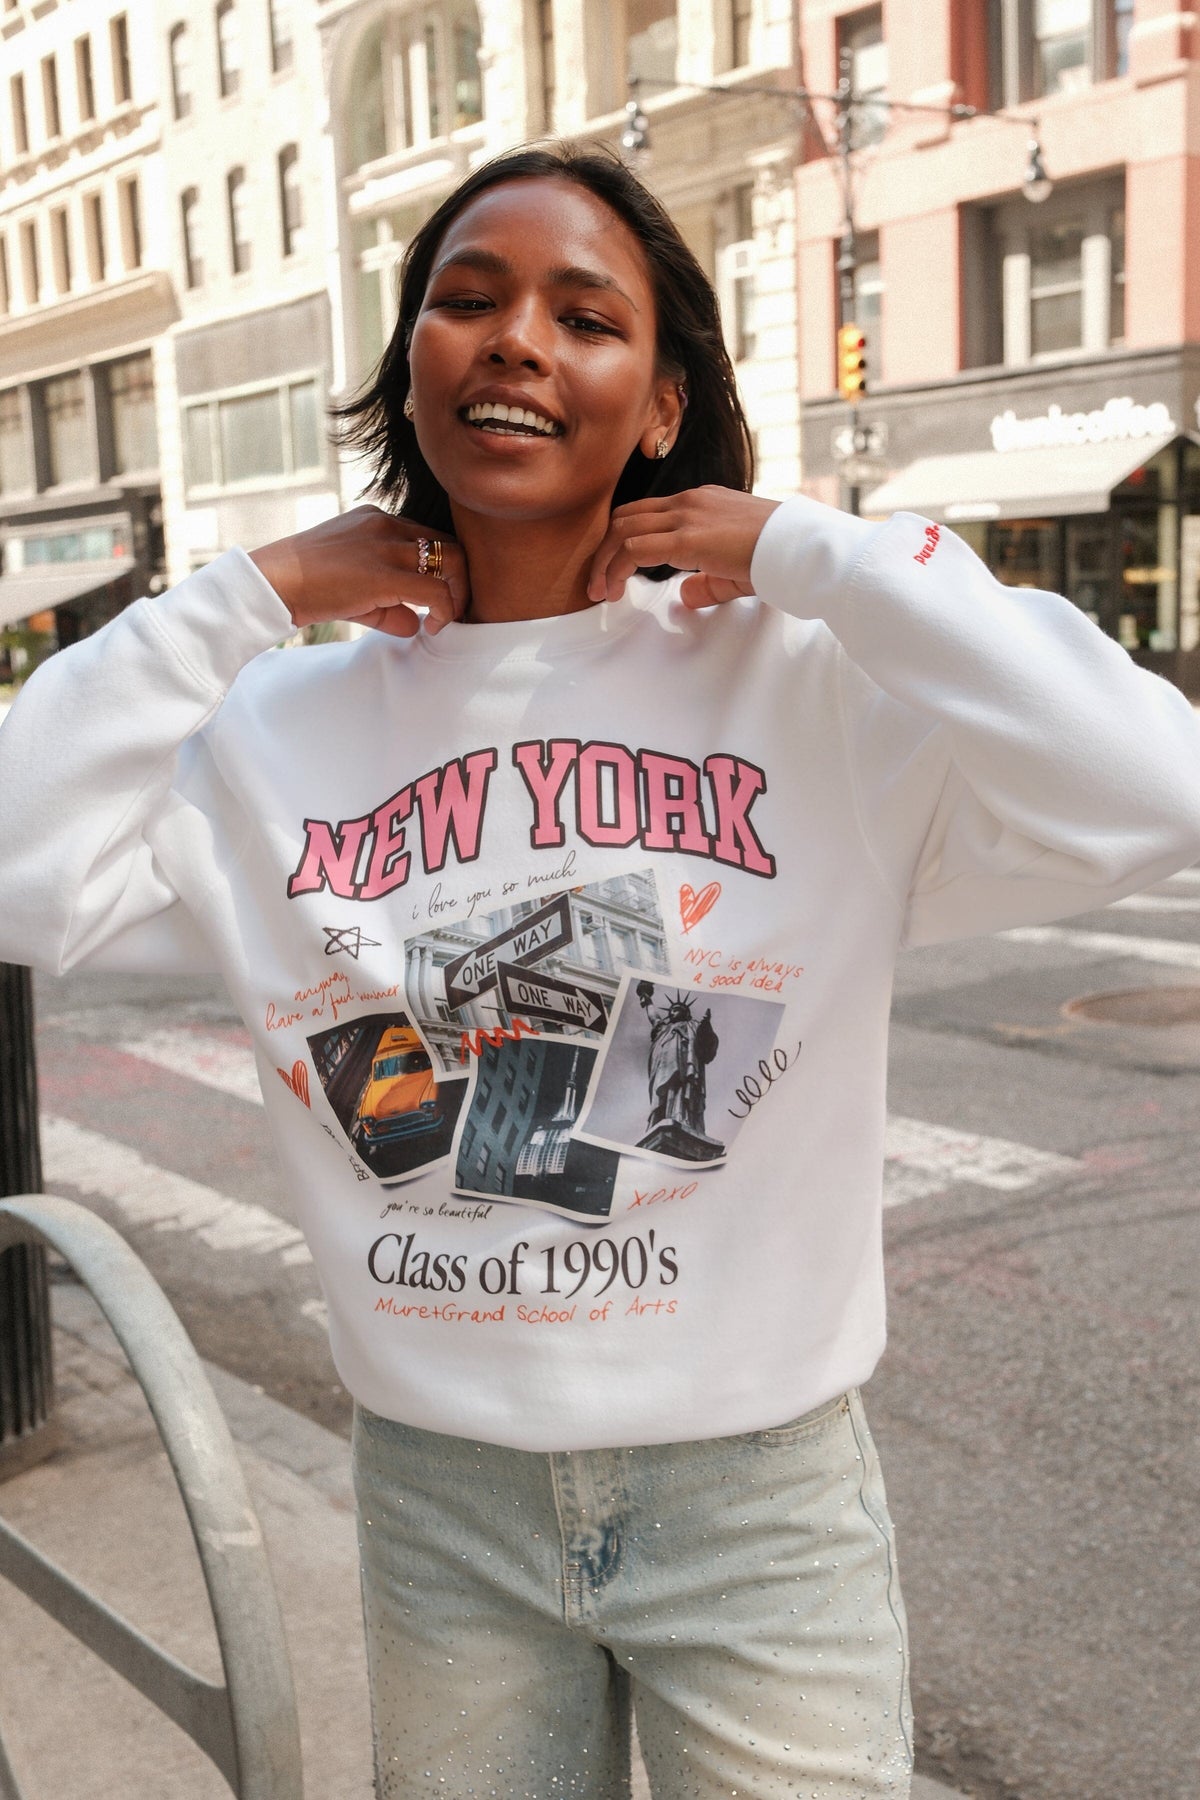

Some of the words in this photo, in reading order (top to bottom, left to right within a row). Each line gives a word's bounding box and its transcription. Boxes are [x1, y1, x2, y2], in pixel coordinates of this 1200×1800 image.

[287, 747, 498, 902] NEW
[512, 738, 777, 880] YORK
[428, 882, 458, 918] love
[466, 888, 492, 919] you
[502, 881, 520, 896] so
[527, 850, 577, 888] much
[462, 952, 497, 986] ONE
[513, 919, 553, 957] WAY
[684, 948, 722, 968] NYC
[728, 955, 742, 971] is
[747, 958, 805, 981] always
[693, 972, 703, 984] a
[709, 971, 747, 988] good
[749, 974, 783, 993] idea
[265, 1002, 304, 1031] have
[312, 1007, 324, 1017] a
[330, 993, 355, 1020] fun
[517, 984, 553, 1008] ONE
[562, 995, 592, 1018] WAY
[379, 1199, 420, 1219] you're
[423, 1207, 434, 1216] so
[438, 1202, 493, 1223] beautiful
[366, 1232, 467, 1293] Class
[478, 1242, 530, 1295] of
[539, 1229, 680, 1300] 1990's
[516, 1304, 577, 1324] School
[589, 1301, 613, 1321] of
[625, 1295, 678, 1316] Arts
